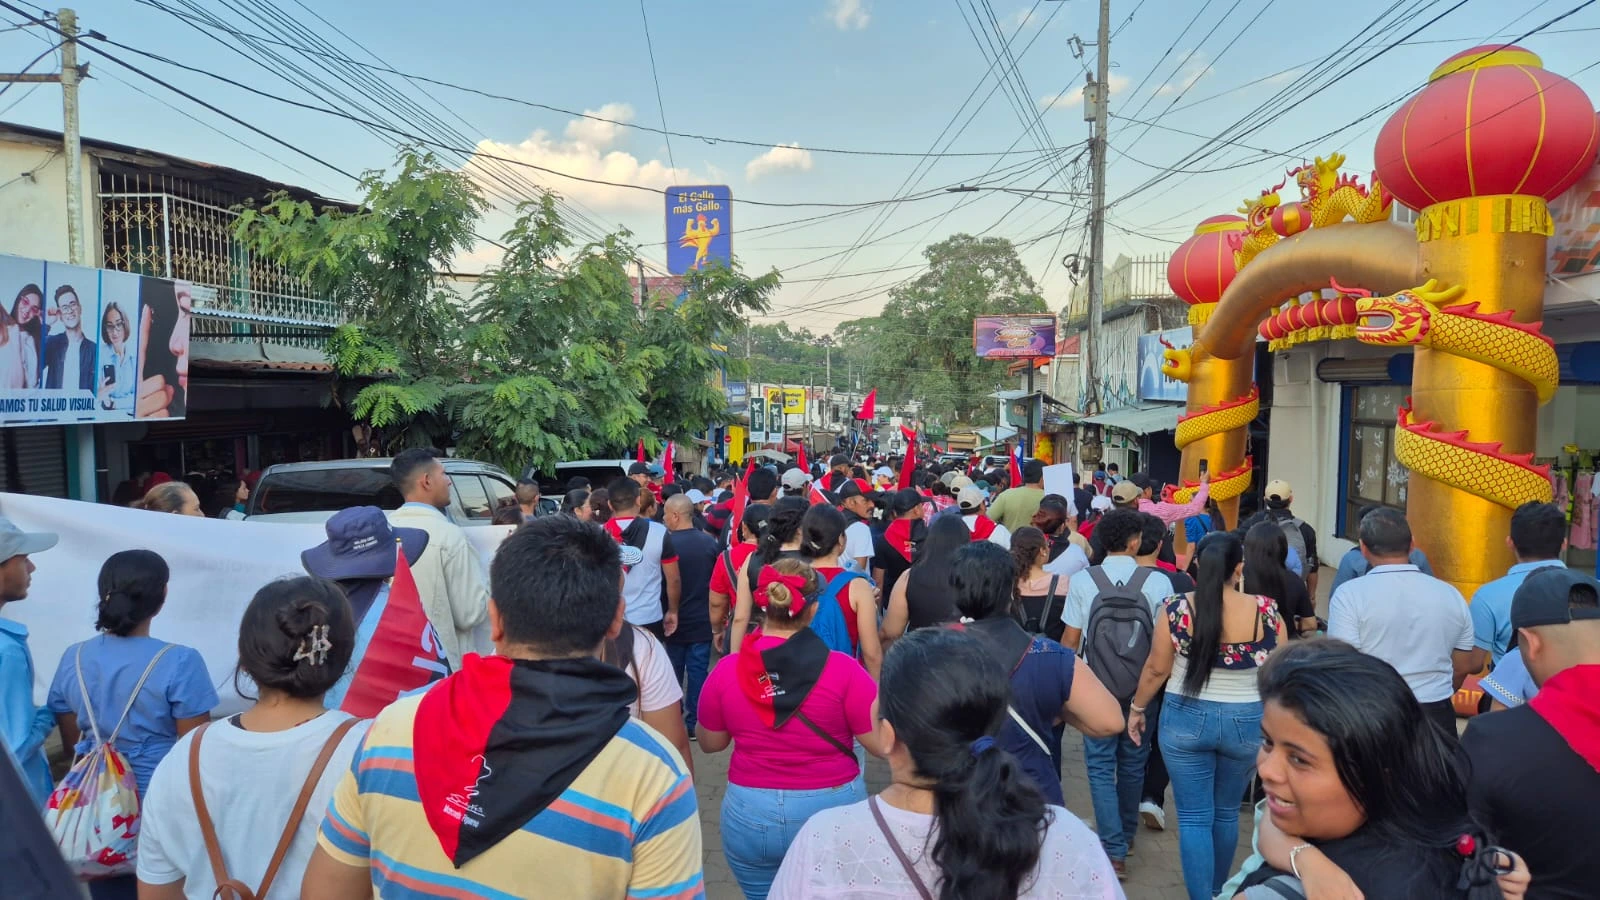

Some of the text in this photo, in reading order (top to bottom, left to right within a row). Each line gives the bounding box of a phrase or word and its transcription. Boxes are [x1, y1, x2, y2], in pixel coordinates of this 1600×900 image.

[678, 190, 714, 203] El Gallo
[695, 201, 720, 212] Gallo
[0, 397, 96, 413] AMOS TU SALUD VISUAL
